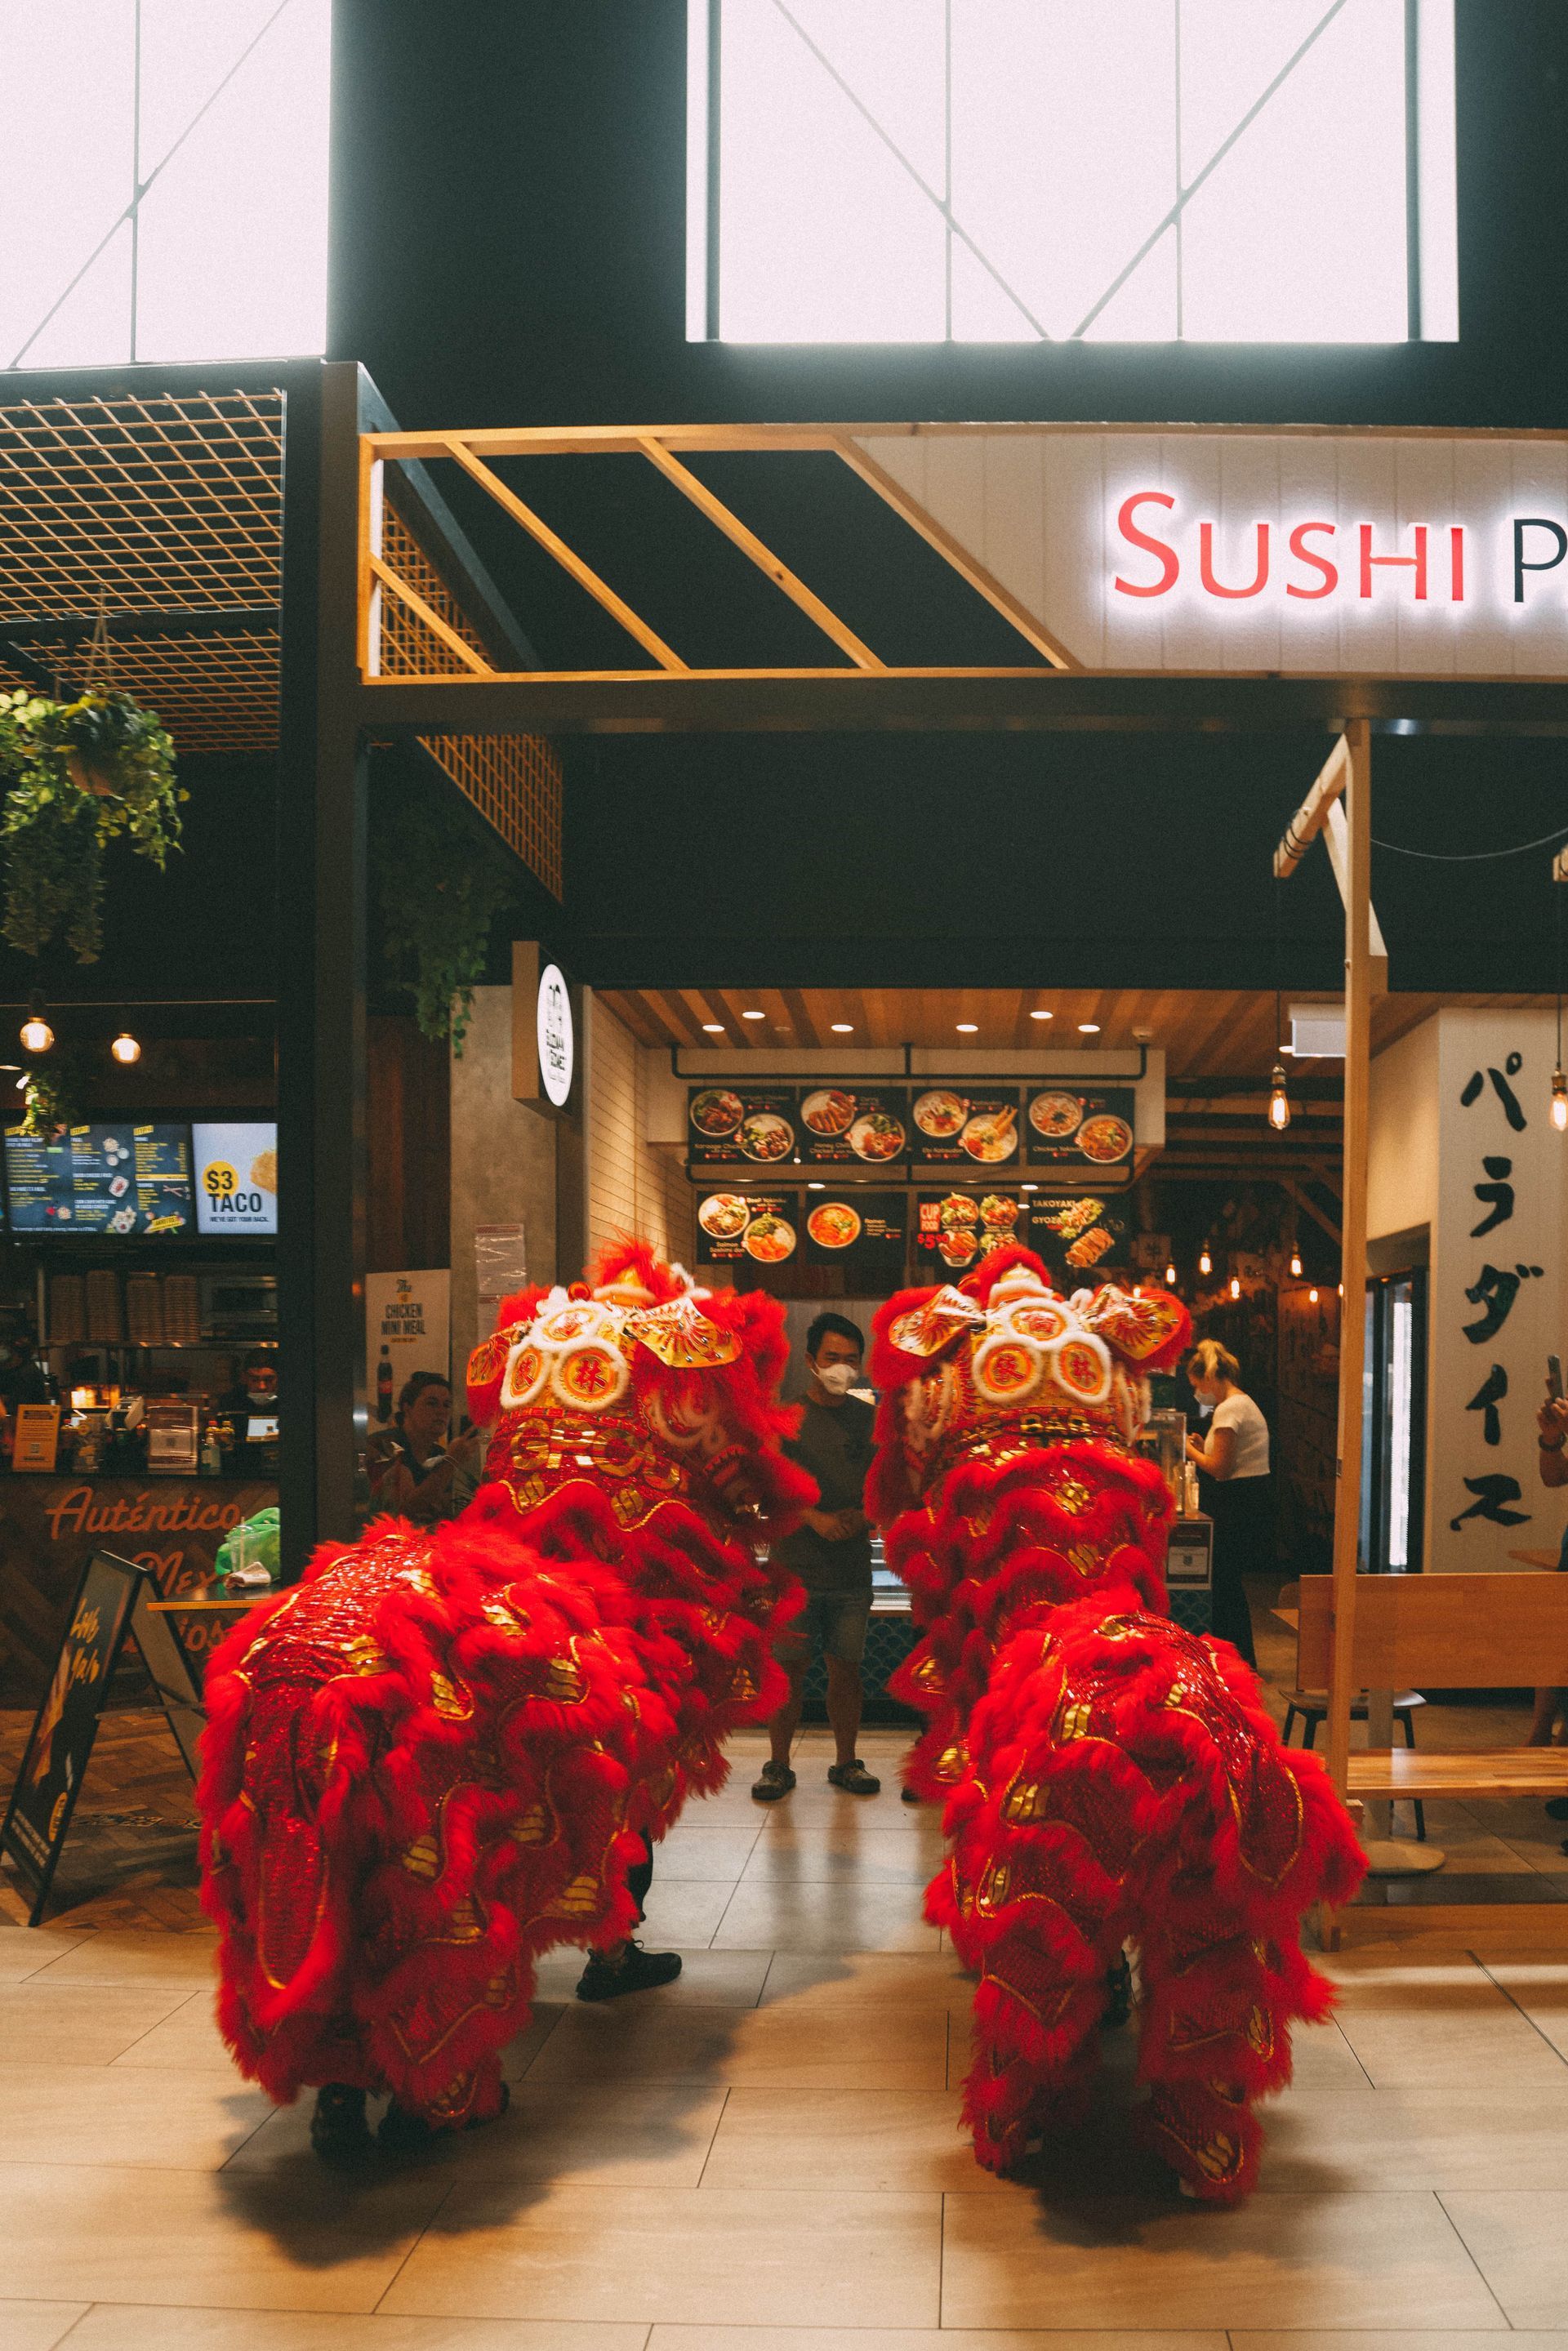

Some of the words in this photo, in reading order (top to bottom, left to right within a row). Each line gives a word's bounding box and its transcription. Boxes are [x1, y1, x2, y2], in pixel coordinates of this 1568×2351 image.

[1114, 491, 1464, 602] SUSHI
[207, 1169, 234, 1191] $3
[207, 1192, 262, 1213] TACO
[920, 1204, 940, 1220] CUP
[1032, 1200, 1076, 1208] TAKOYAKI
[1450, 1051, 1544, 1531] パラダイス
[385, 1303, 423, 1319] CHICKEN
[44, 1486, 242, 1540] Auténtico
[131, 1551, 217, 1596] Mex
